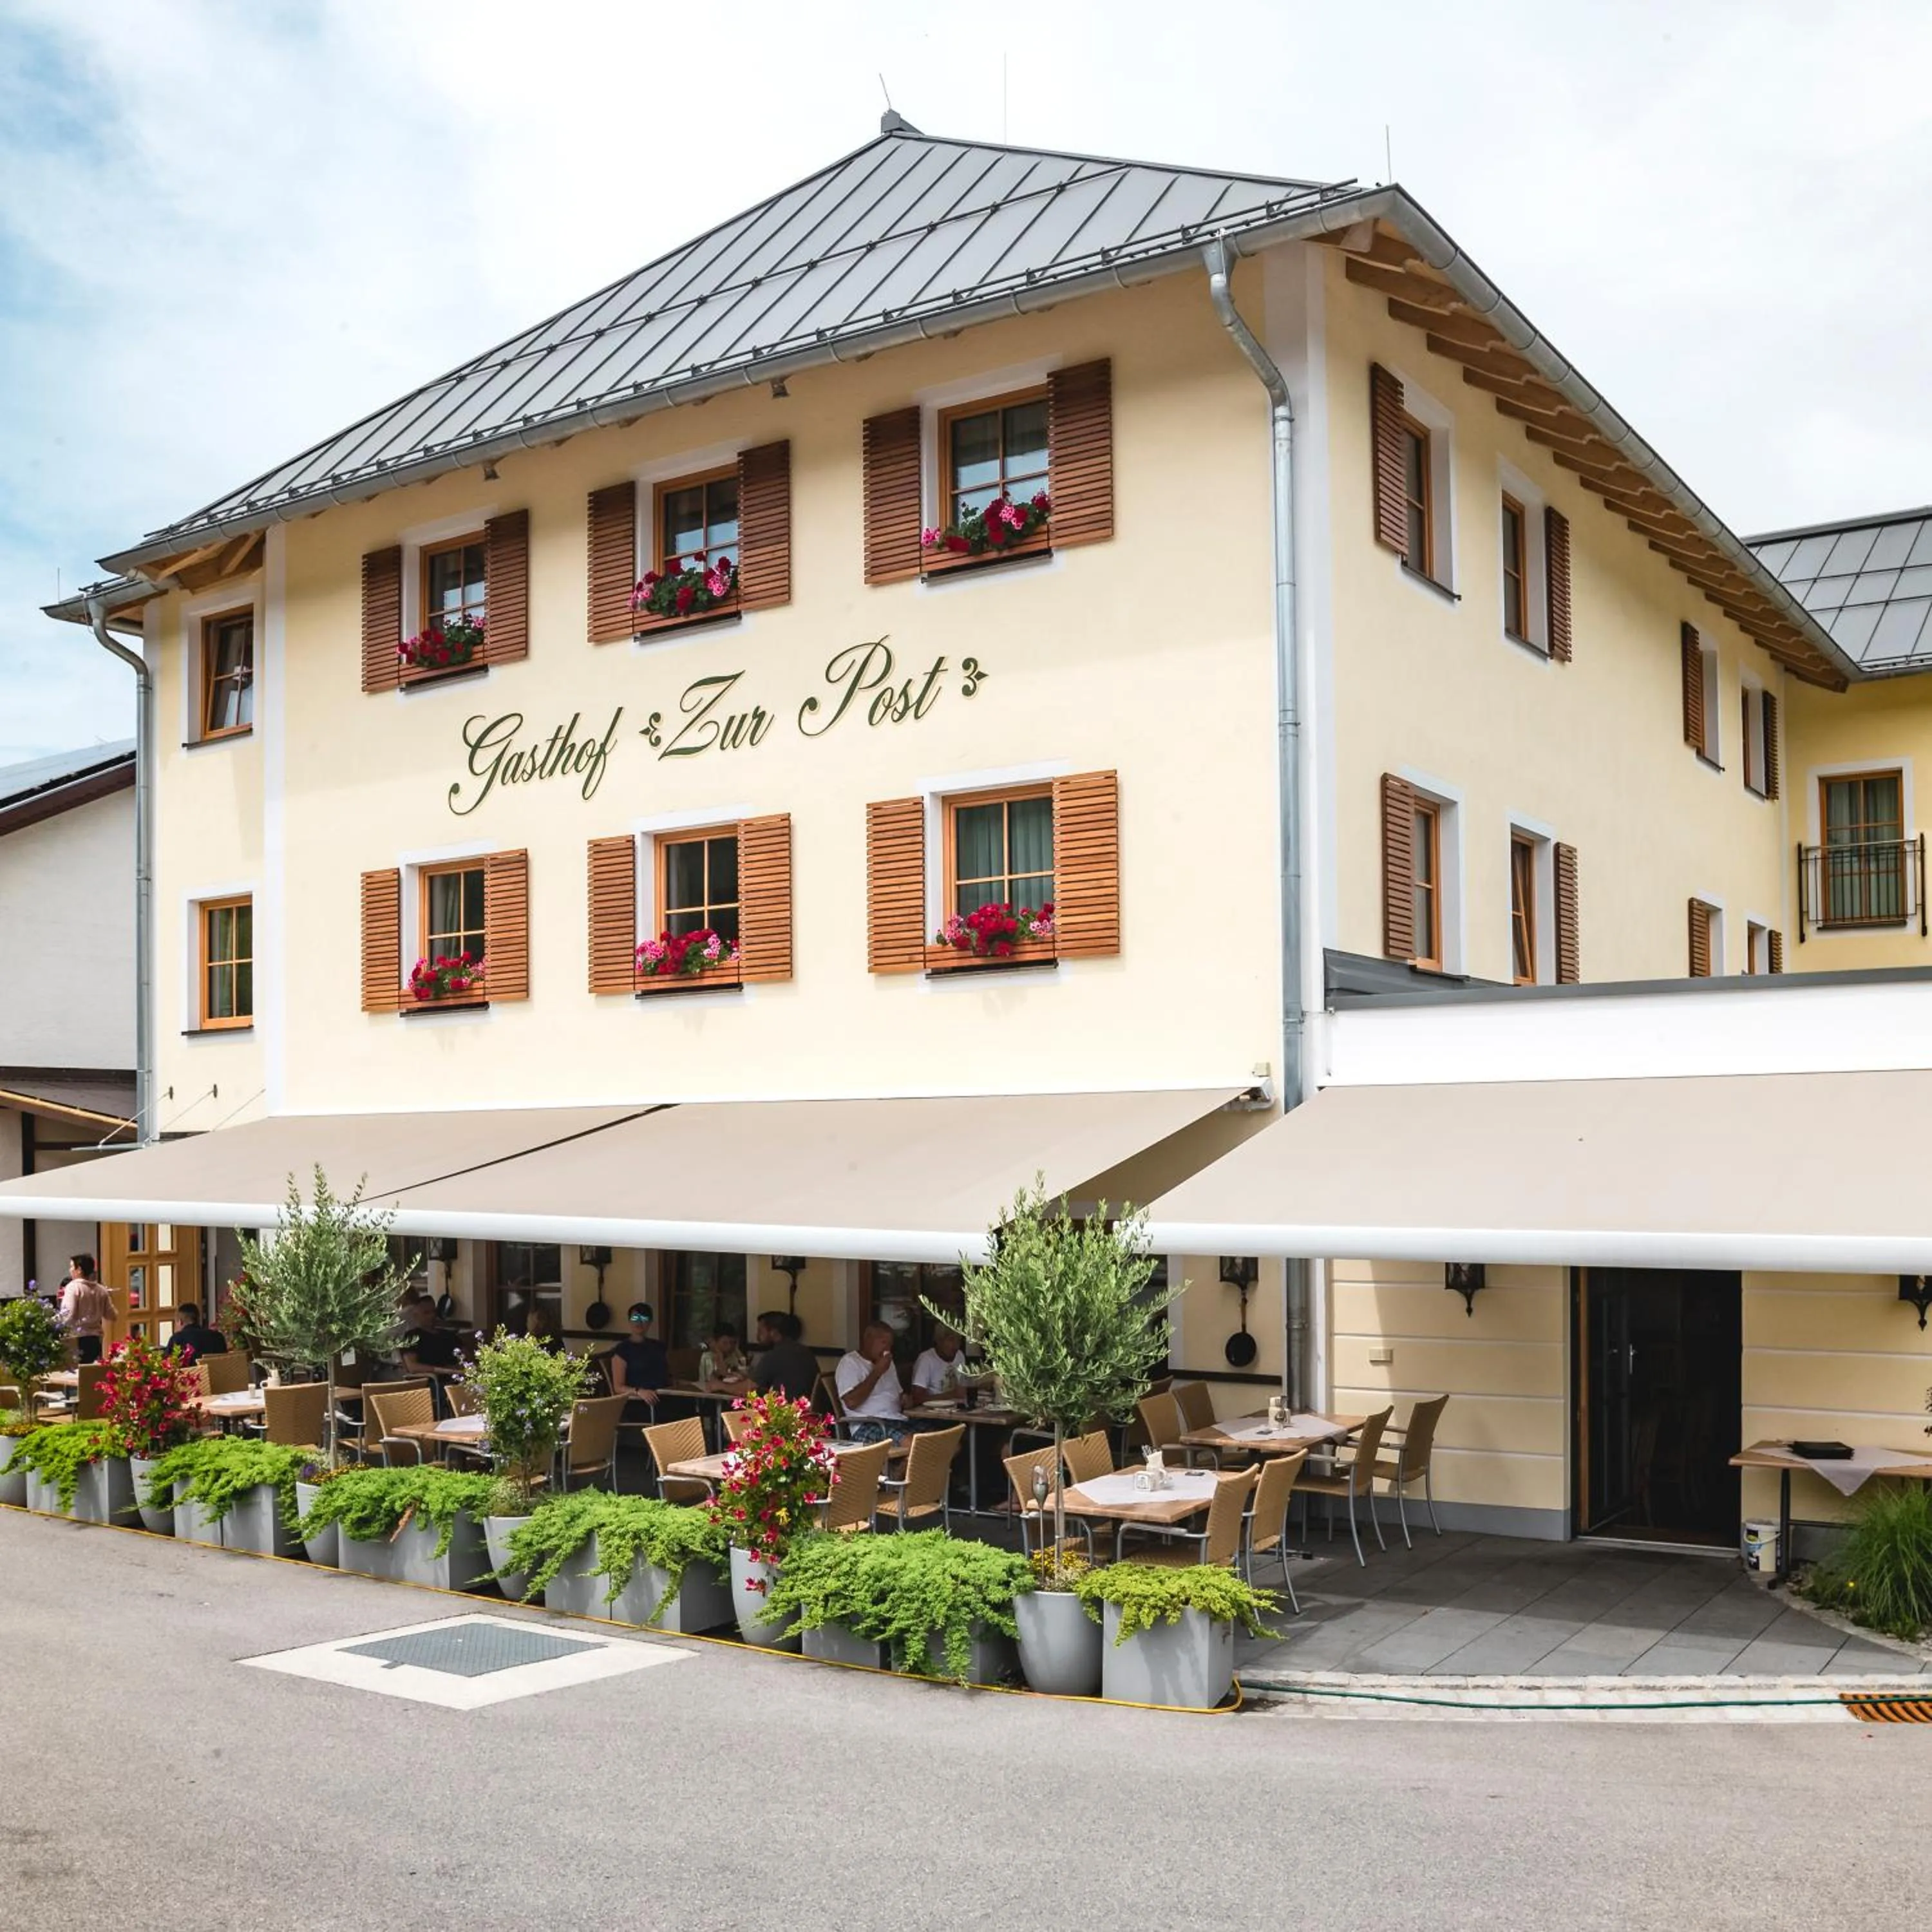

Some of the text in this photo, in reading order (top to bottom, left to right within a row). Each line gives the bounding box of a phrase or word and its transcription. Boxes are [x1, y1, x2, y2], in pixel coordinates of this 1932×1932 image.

[448, 635, 949, 815] Gasthof Zur Post
